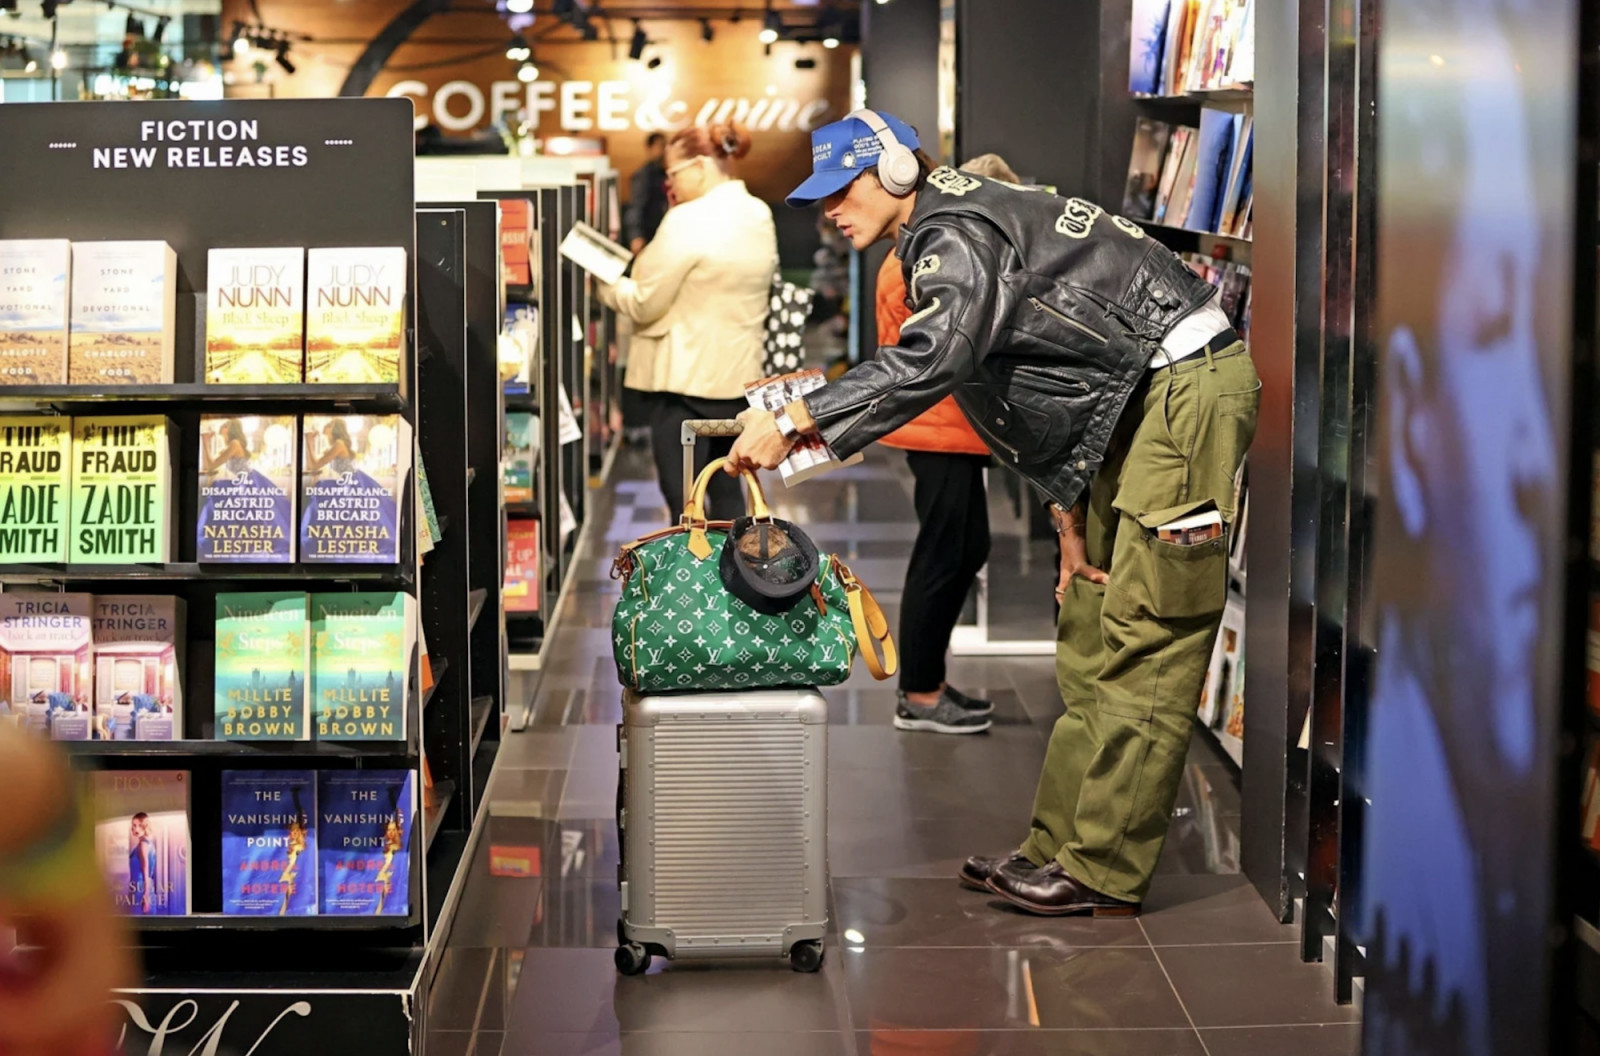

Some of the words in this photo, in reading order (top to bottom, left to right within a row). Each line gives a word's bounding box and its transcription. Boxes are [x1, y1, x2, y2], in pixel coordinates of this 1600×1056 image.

[385, 80, 631, 132] COFFEE
[141, 119, 258, 141] FICTION
[92, 147, 157, 169] NEW
[167, 146, 308, 167] RELEASES
[4, 267, 37, 275] STONE
[226, 265, 286, 287] JUDY
[325, 264, 386, 287] JUDY
[6, 285, 33, 293] YARD
[218, 286, 292, 308] NUNN
[318, 285, 391, 308] NUNN
[82, 305, 151, 313] DEVOTIONAL
[84, 350, 146, 358] CHARLOTTE
[1, 367, 33, 375] WOOD
[99, 368, 131, 376] WOOD
[0, 451, 62, 473] RAUD
[81, 450, 157, 473] FRAUD
[231, 471, 254, 486] The
[336, 471, 359, 486] The
[201, 487, 288, 496] DISAPPEARANCE
[305, 487, 393, 496] DISAPPEARANCE
[0, 484, 60, 525] ADIE
[80, 483, 156, 525] ZADIE
[223, 497, 275, 509] ASTRID
[328, 497, 380, 509] ASTRID
[213, 510, 275, 521] BRICARD
[317, 510, 380, 521] BRICARD
[203, 525, 285, 539] NATASHA
[307, 525, 390, 539] NATASHA
[0, 528, 58, 554] MITH
[79, 528, 155, 554] SMITH
[213, 540, 274, 554] LESTER
[317, 540, 379, 554] LESTER
[16, 602, 70, 614] TRICIA
[100, 604, 156, 616] TRICIA
[223, 604, 300, 622] Nineteen
[319, 604, 397, 622] Nineteen
[4, 616, 82, 628] STRINGER
[227, 688, 292, 702] MILLIE
[323, 688, 390, 702] MILLIE
[227, 705, 292, 719] BOBBY
[323, 705, 390, 719] BOBBY
[224, 722, 295, 736] BROWN
[319, 722, 393, 736] BROWN
[254, 791, 281, 801] THE
[350, 790, 378, 801] THE
[228, 814, 308, 825] VANISHING
[324, 814, 405, 825] VANISHING
[247, 837, 290, 848] POINT
[343, 837, 386, 848] POINT
